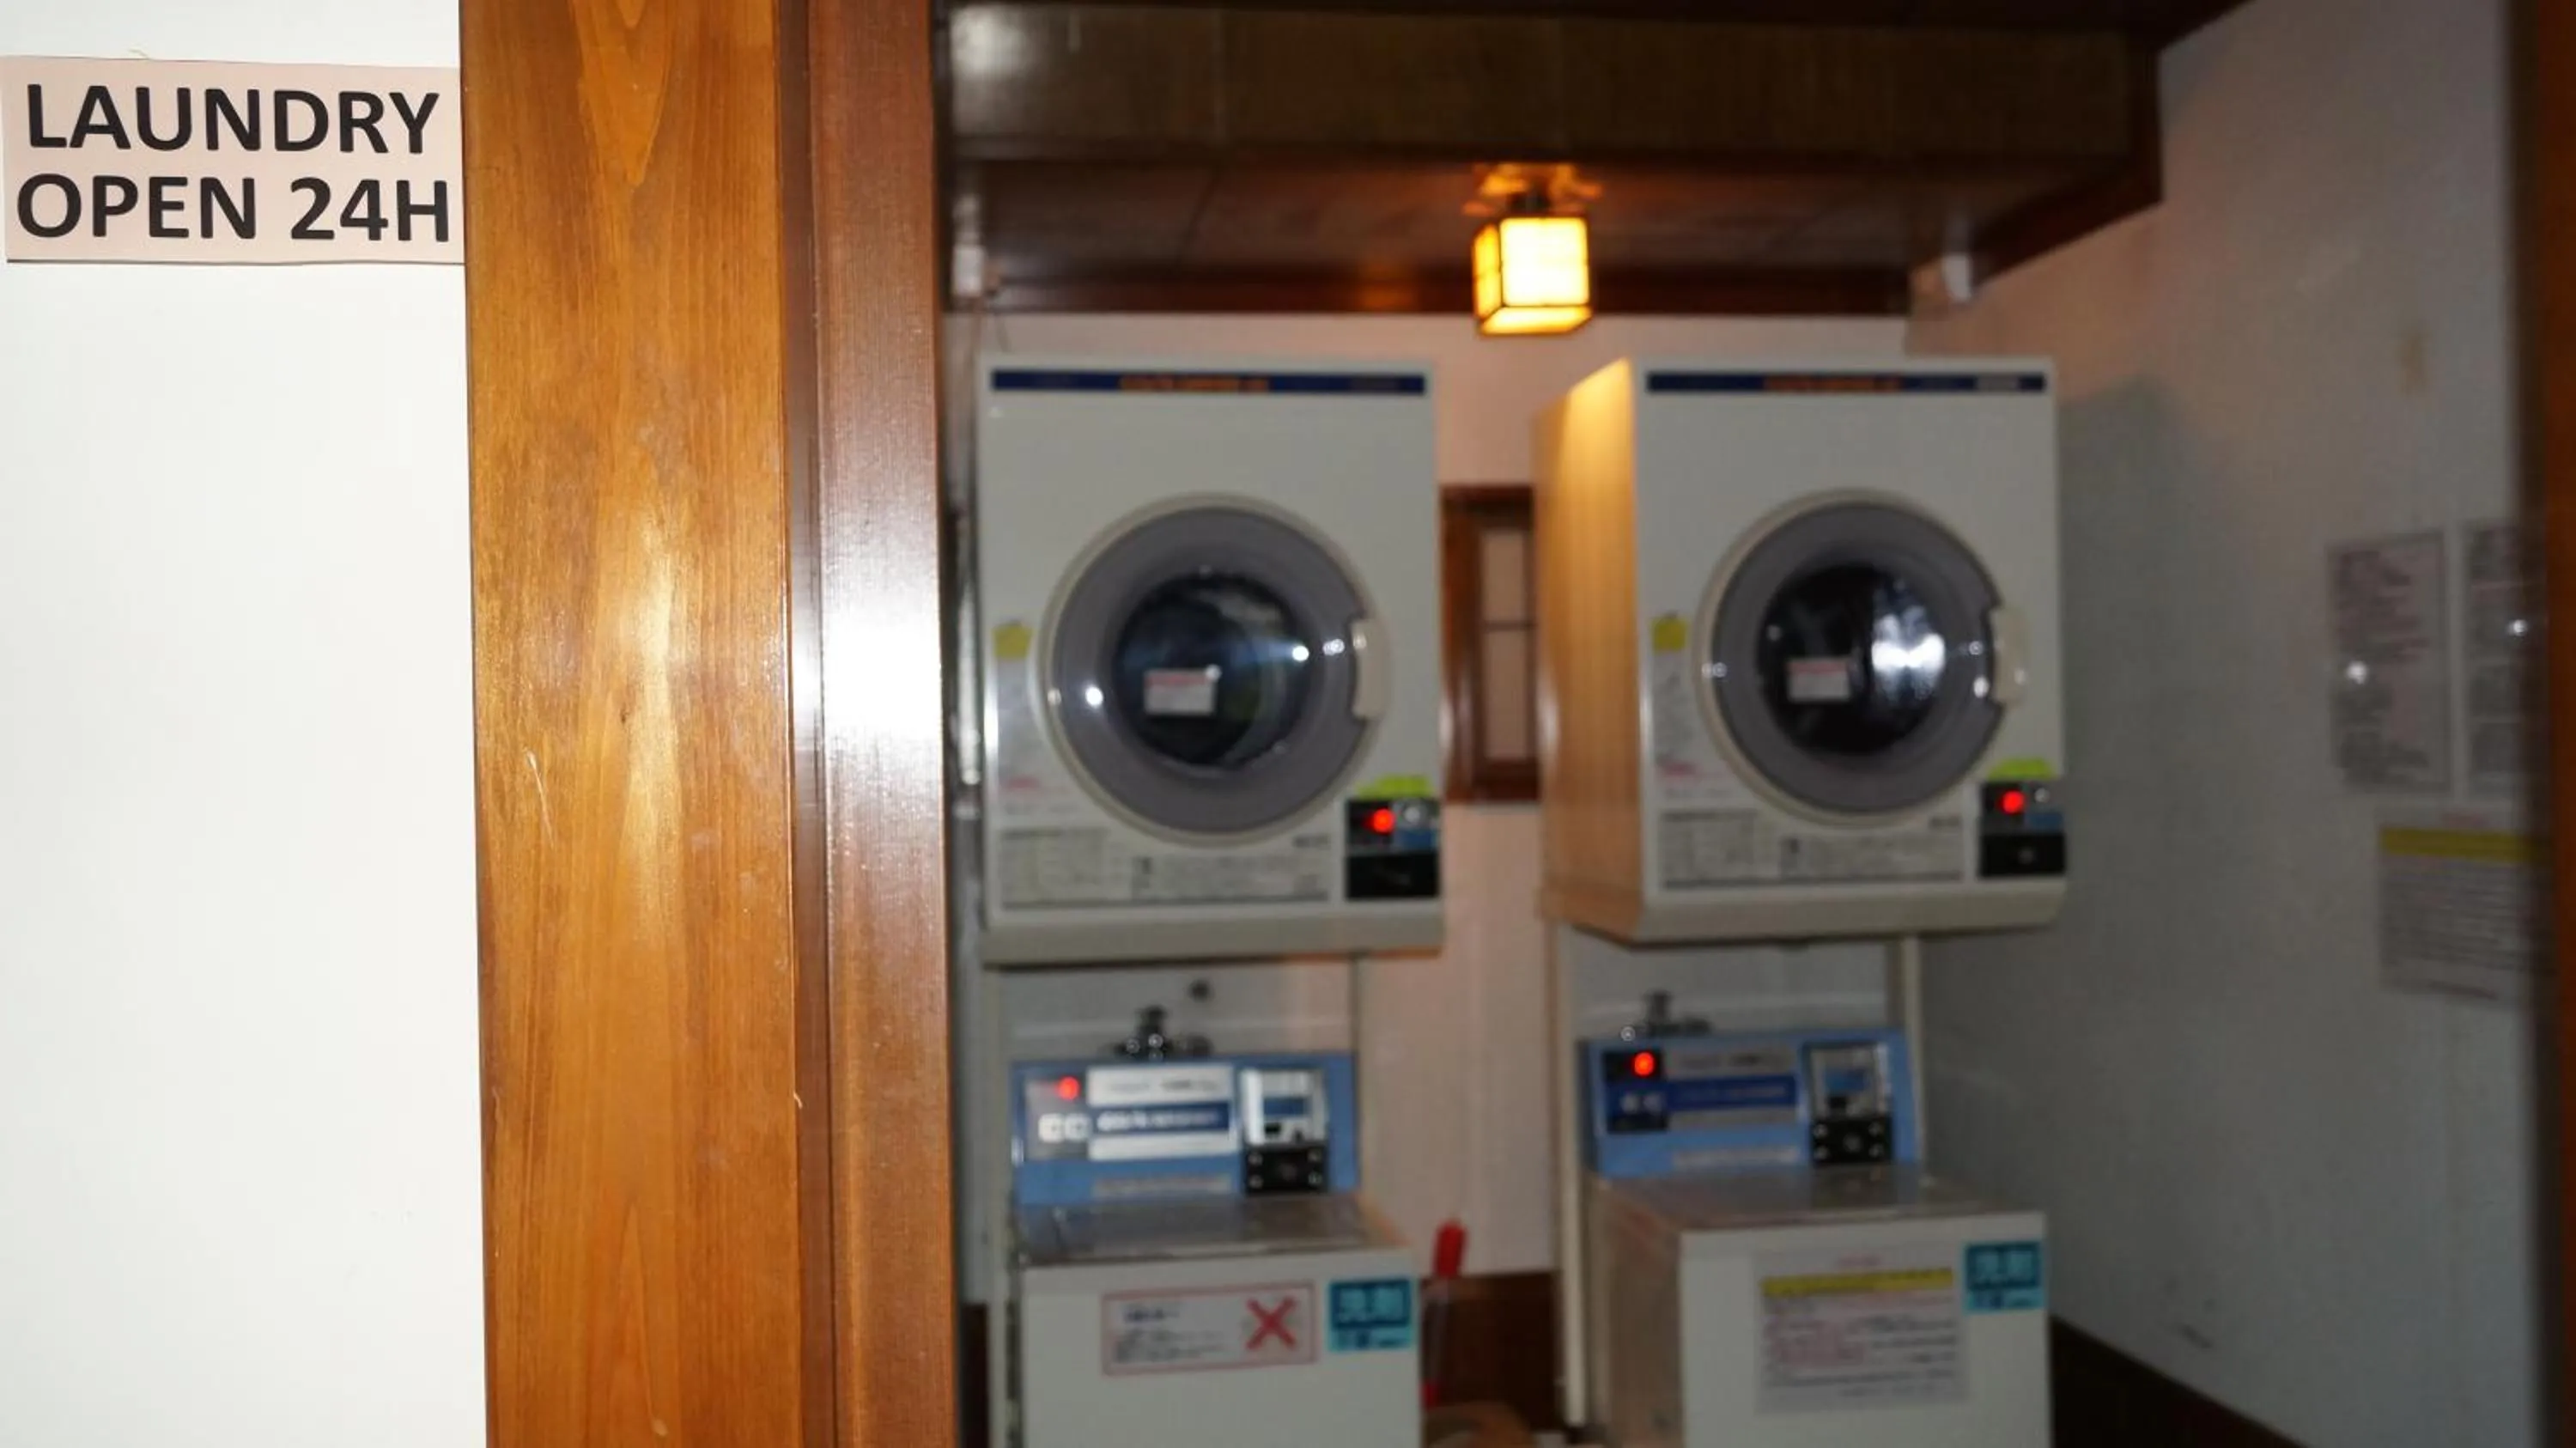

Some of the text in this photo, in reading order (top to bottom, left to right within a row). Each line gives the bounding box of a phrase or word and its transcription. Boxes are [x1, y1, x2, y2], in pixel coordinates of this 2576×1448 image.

[27, 83, 440, 155] LAUNDRY
[17, 173, 450, 242] OPEN 24H
